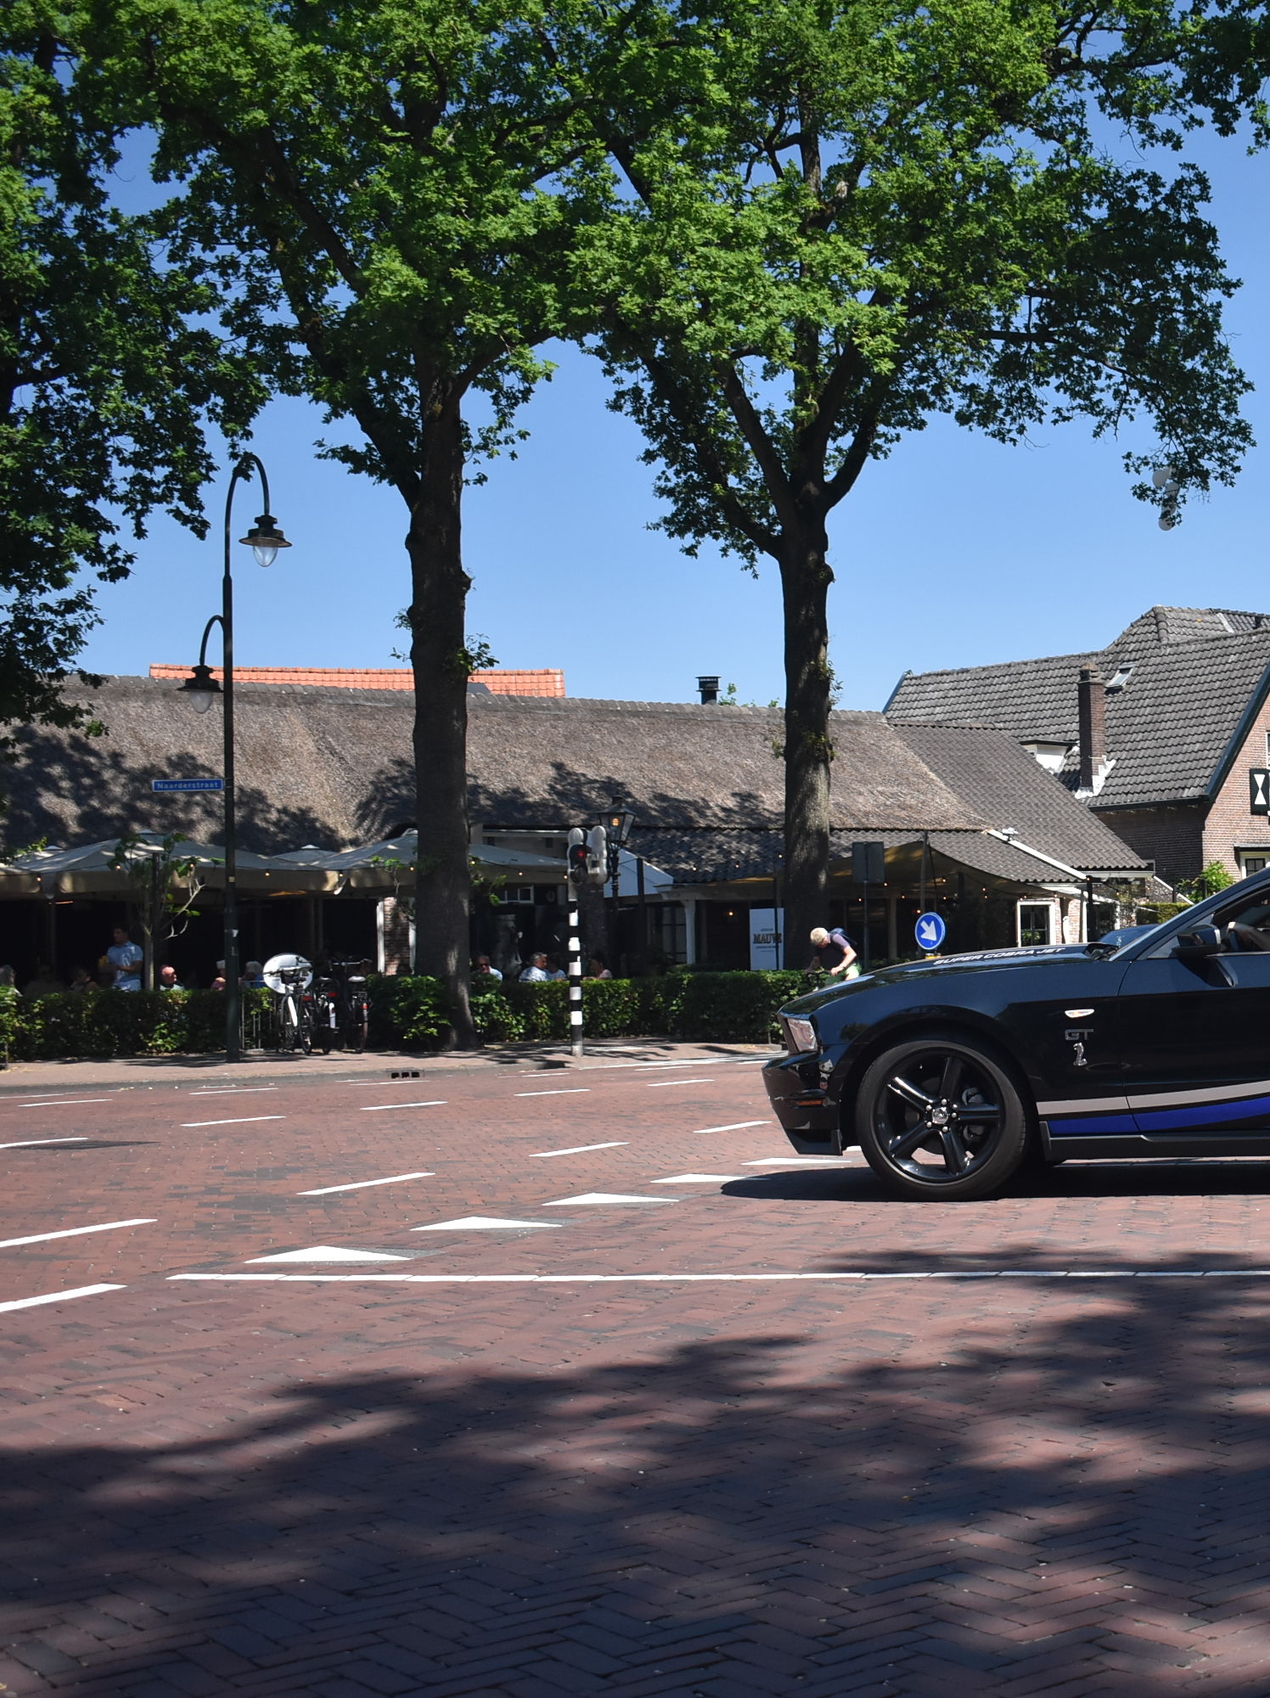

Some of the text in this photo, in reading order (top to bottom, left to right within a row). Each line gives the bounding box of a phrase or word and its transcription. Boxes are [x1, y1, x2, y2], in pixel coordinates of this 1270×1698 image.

[157, 781, 218, 789] Naarderstraat
[933, 947, 1067, 966] SUPER COBRA JET
[1064, 1028, 1094, 1041] GT
